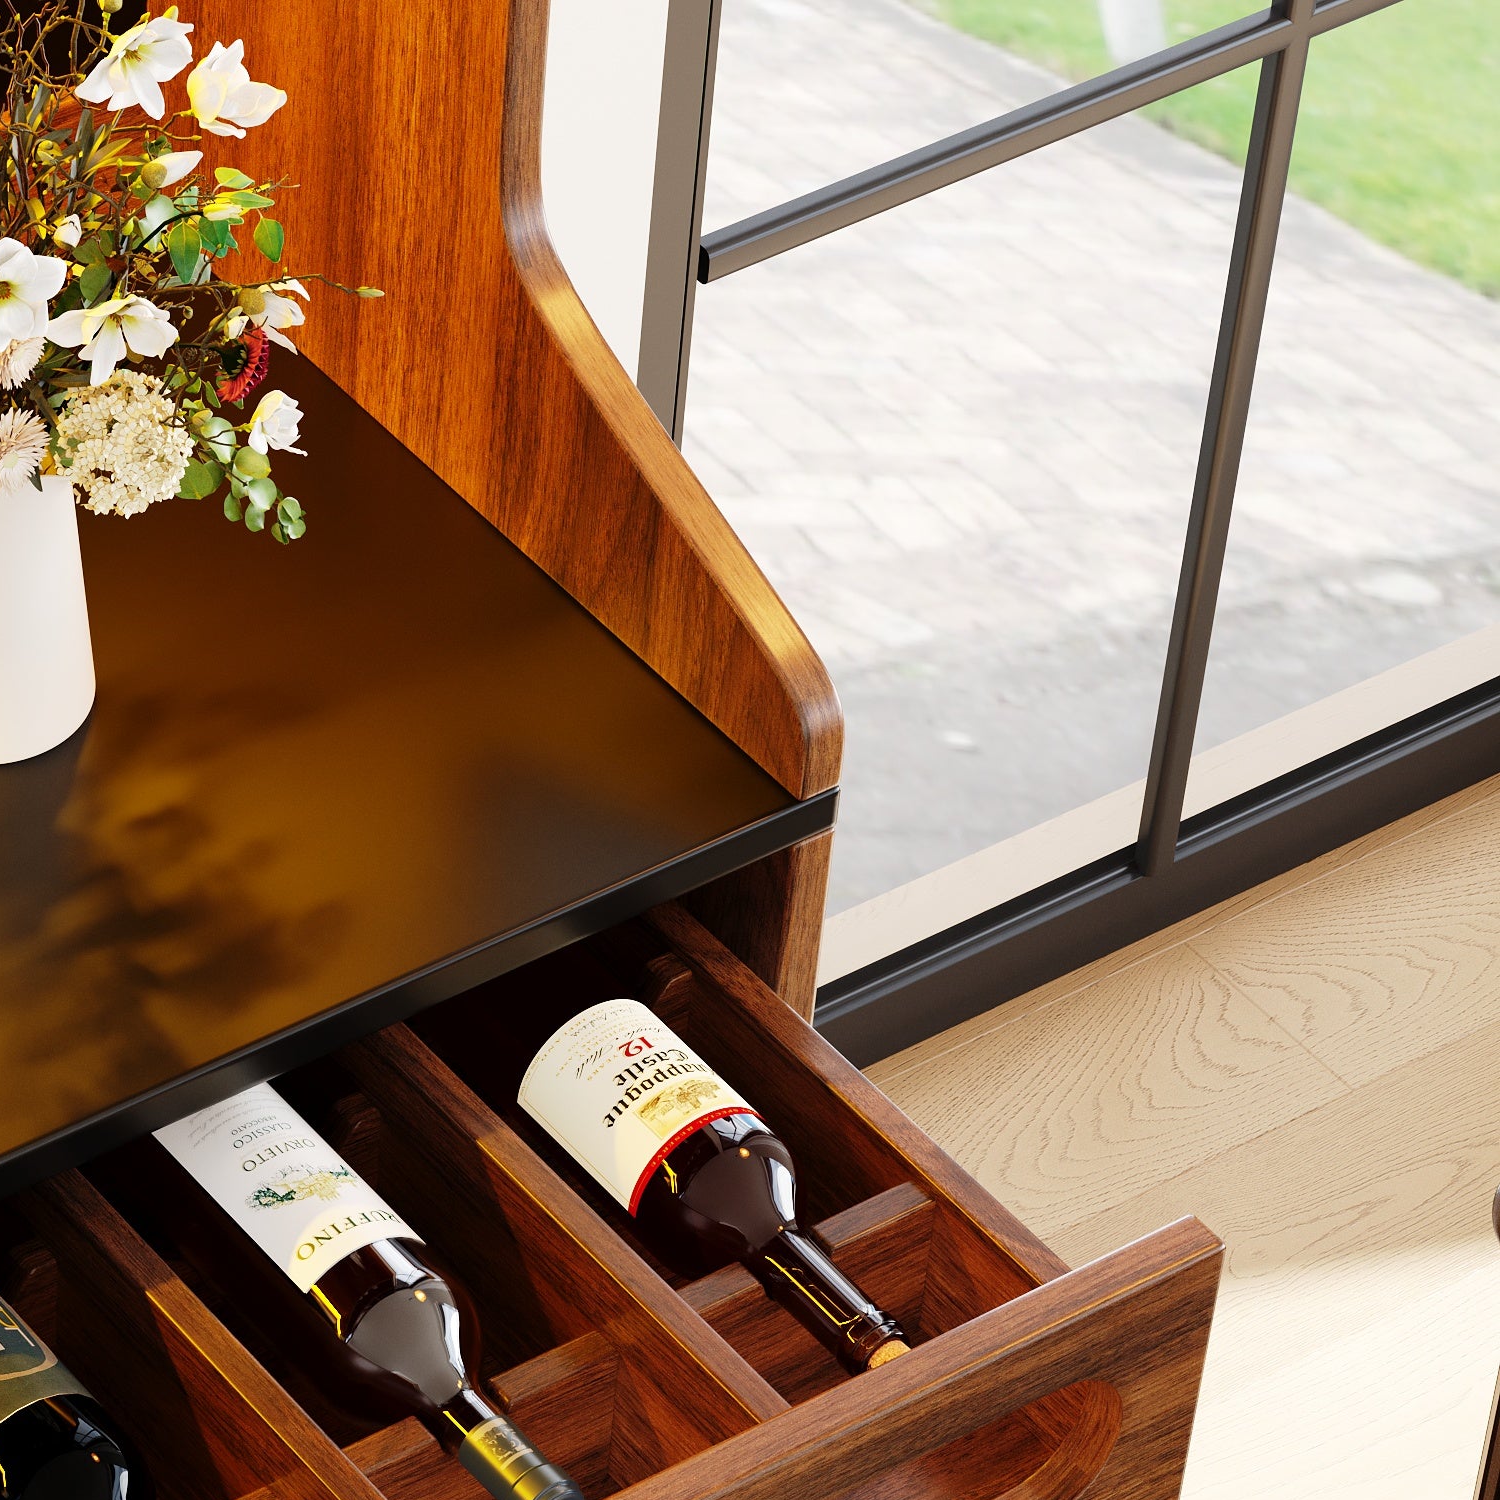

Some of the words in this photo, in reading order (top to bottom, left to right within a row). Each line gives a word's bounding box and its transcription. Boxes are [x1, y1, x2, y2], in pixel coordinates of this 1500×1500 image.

[618, 1036, 654, 1058] 12
[612, 1048, 689, 1087] Castle
[233, 1121, 292, 1149] CLASSICO
[242, 1138, 316, 1173] ORVIETO
[296, 1209, 402, 1262] RUFFINO
